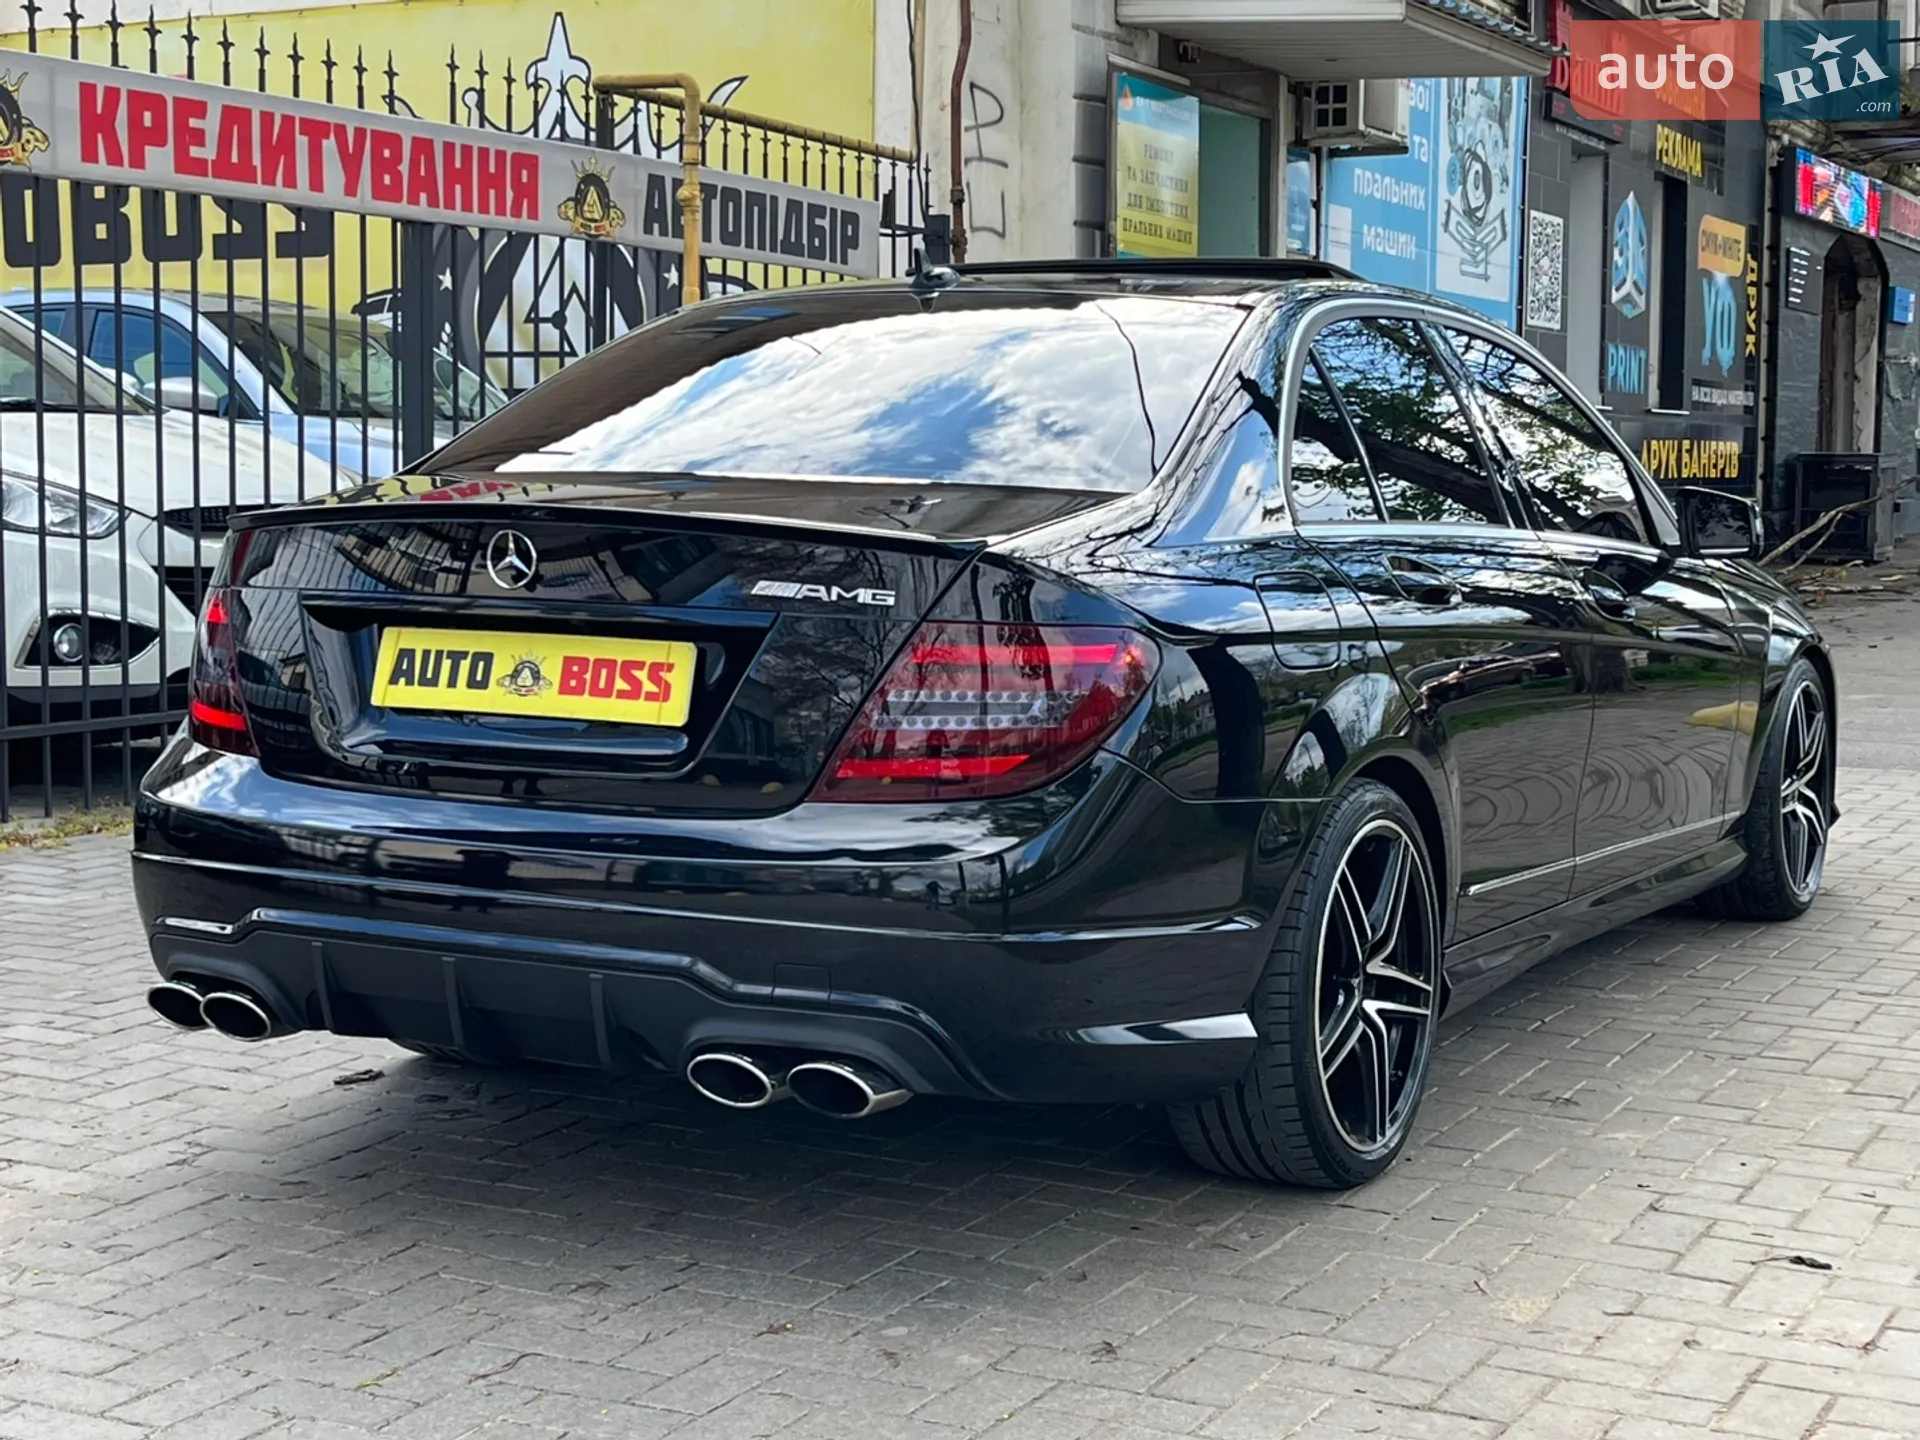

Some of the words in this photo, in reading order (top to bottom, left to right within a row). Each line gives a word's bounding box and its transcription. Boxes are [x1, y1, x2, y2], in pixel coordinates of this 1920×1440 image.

[79, 82, 540, 221] КРЕДИТУВАННЯ
[1412, 135, 1428, 163] та
[1655, 123, 1703, 178] РЕКЛАМА
[1354, 167, 1427, 211] пральних
[1362, 224, 1417, 261] машин
[1745, 252, 1758, 358] ДРУК
[1607, 343, 1647, 395] PRINT
[1681, 439, 1739, 479] БАНЕРІВ
[800, 585, 895, 606] AMG
[388, 647, 494, 690] AUTO
[557, 655, 675, 703] BOSS
